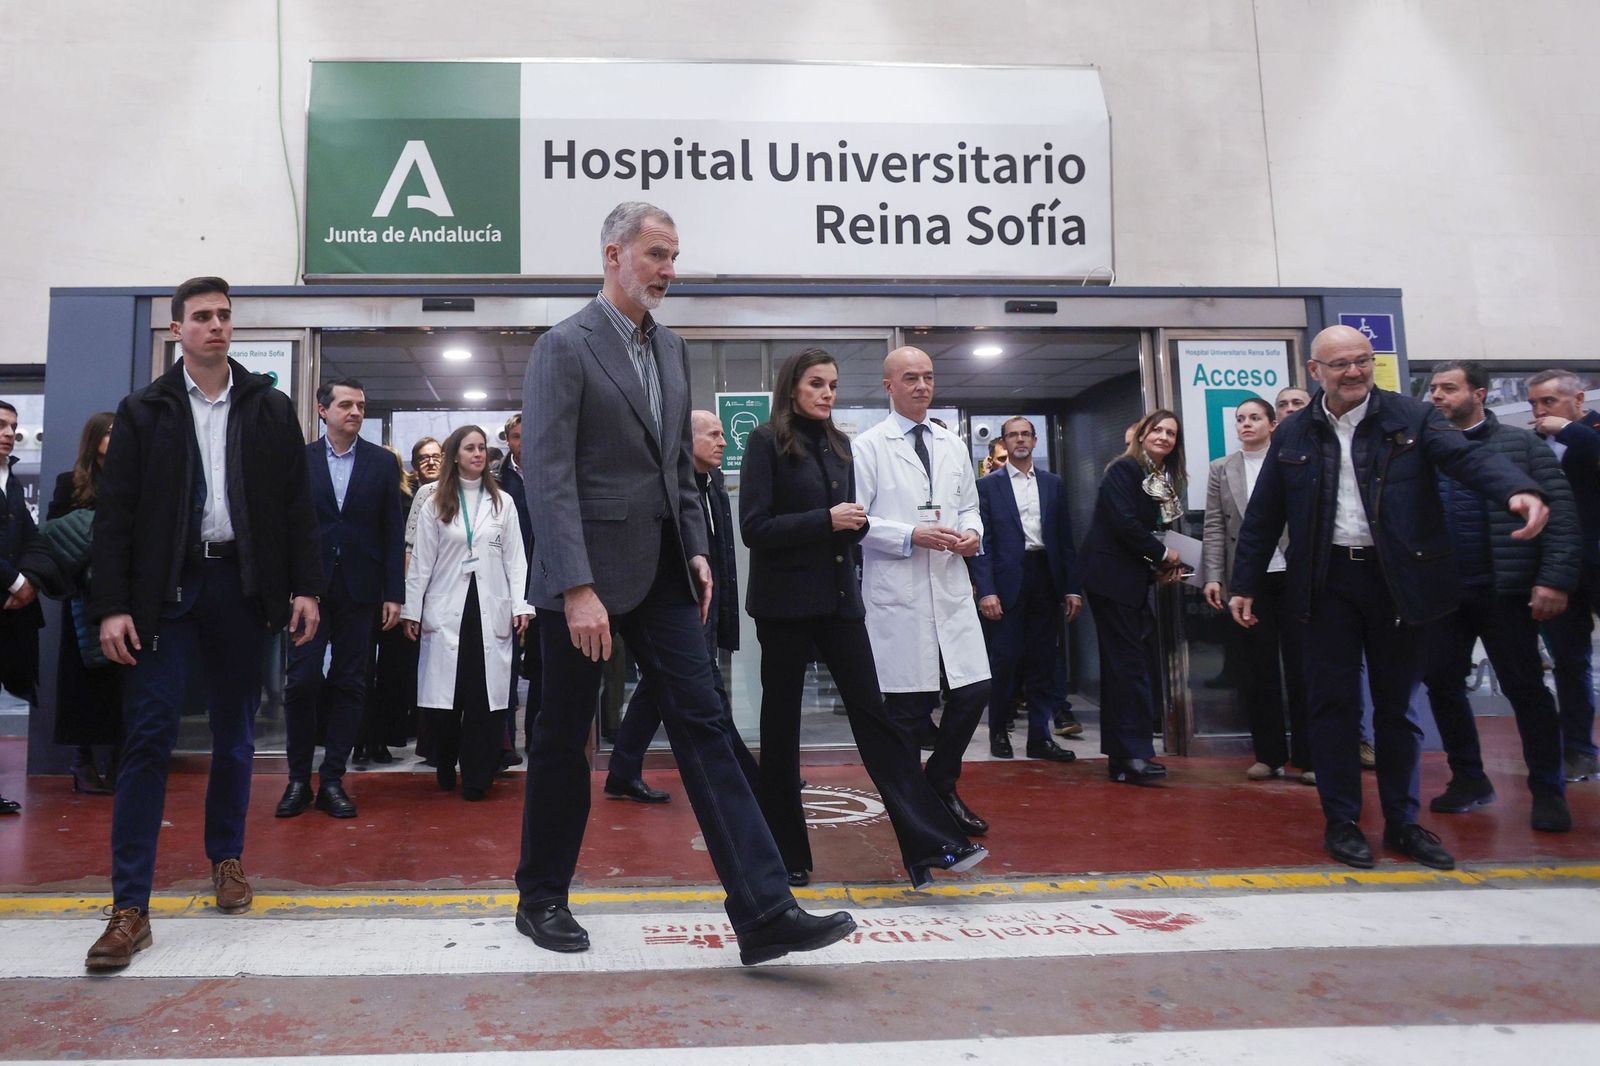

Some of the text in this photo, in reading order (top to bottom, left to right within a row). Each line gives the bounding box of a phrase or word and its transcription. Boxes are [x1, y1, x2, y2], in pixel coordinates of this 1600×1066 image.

[544, 137, 1086, 191] Hospital Universitario
[816, 197, 1086, 246] Reina Sofía
[323, 223, 502, 243] Junta de Andalucía
[1185, 349, 1209, 357] Hospital
[1193, 363, 1277, 387] Acceso
[959, 922, 1119, 940] Regala
